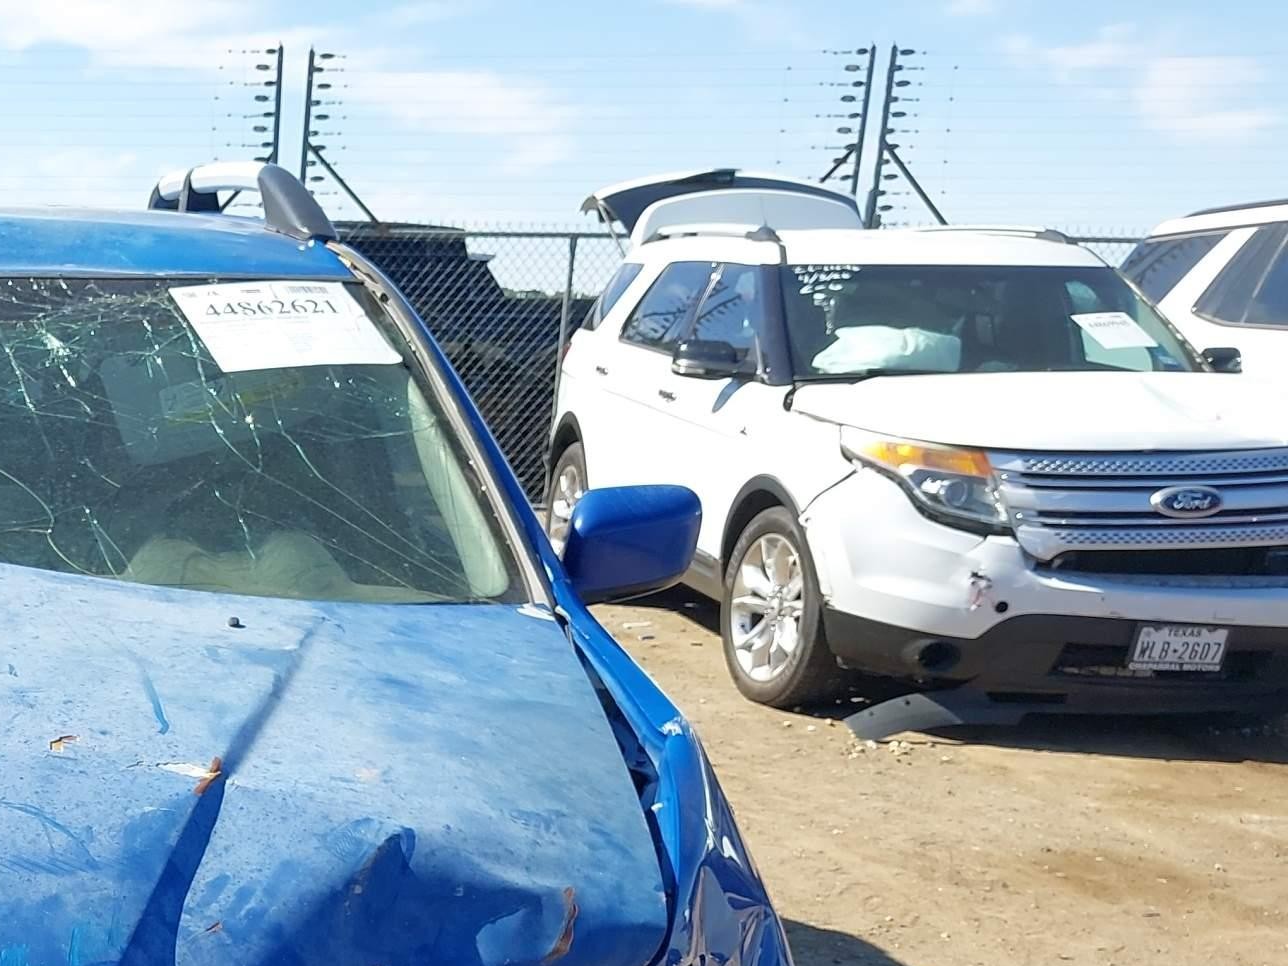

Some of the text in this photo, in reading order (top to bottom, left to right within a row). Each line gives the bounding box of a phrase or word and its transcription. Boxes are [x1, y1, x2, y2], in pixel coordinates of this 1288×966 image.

[205, 299, 340, 316] 44862621
[1173, 492, 1212, 510] Ford
[1168, 628, 1202, 637] TEXAS
